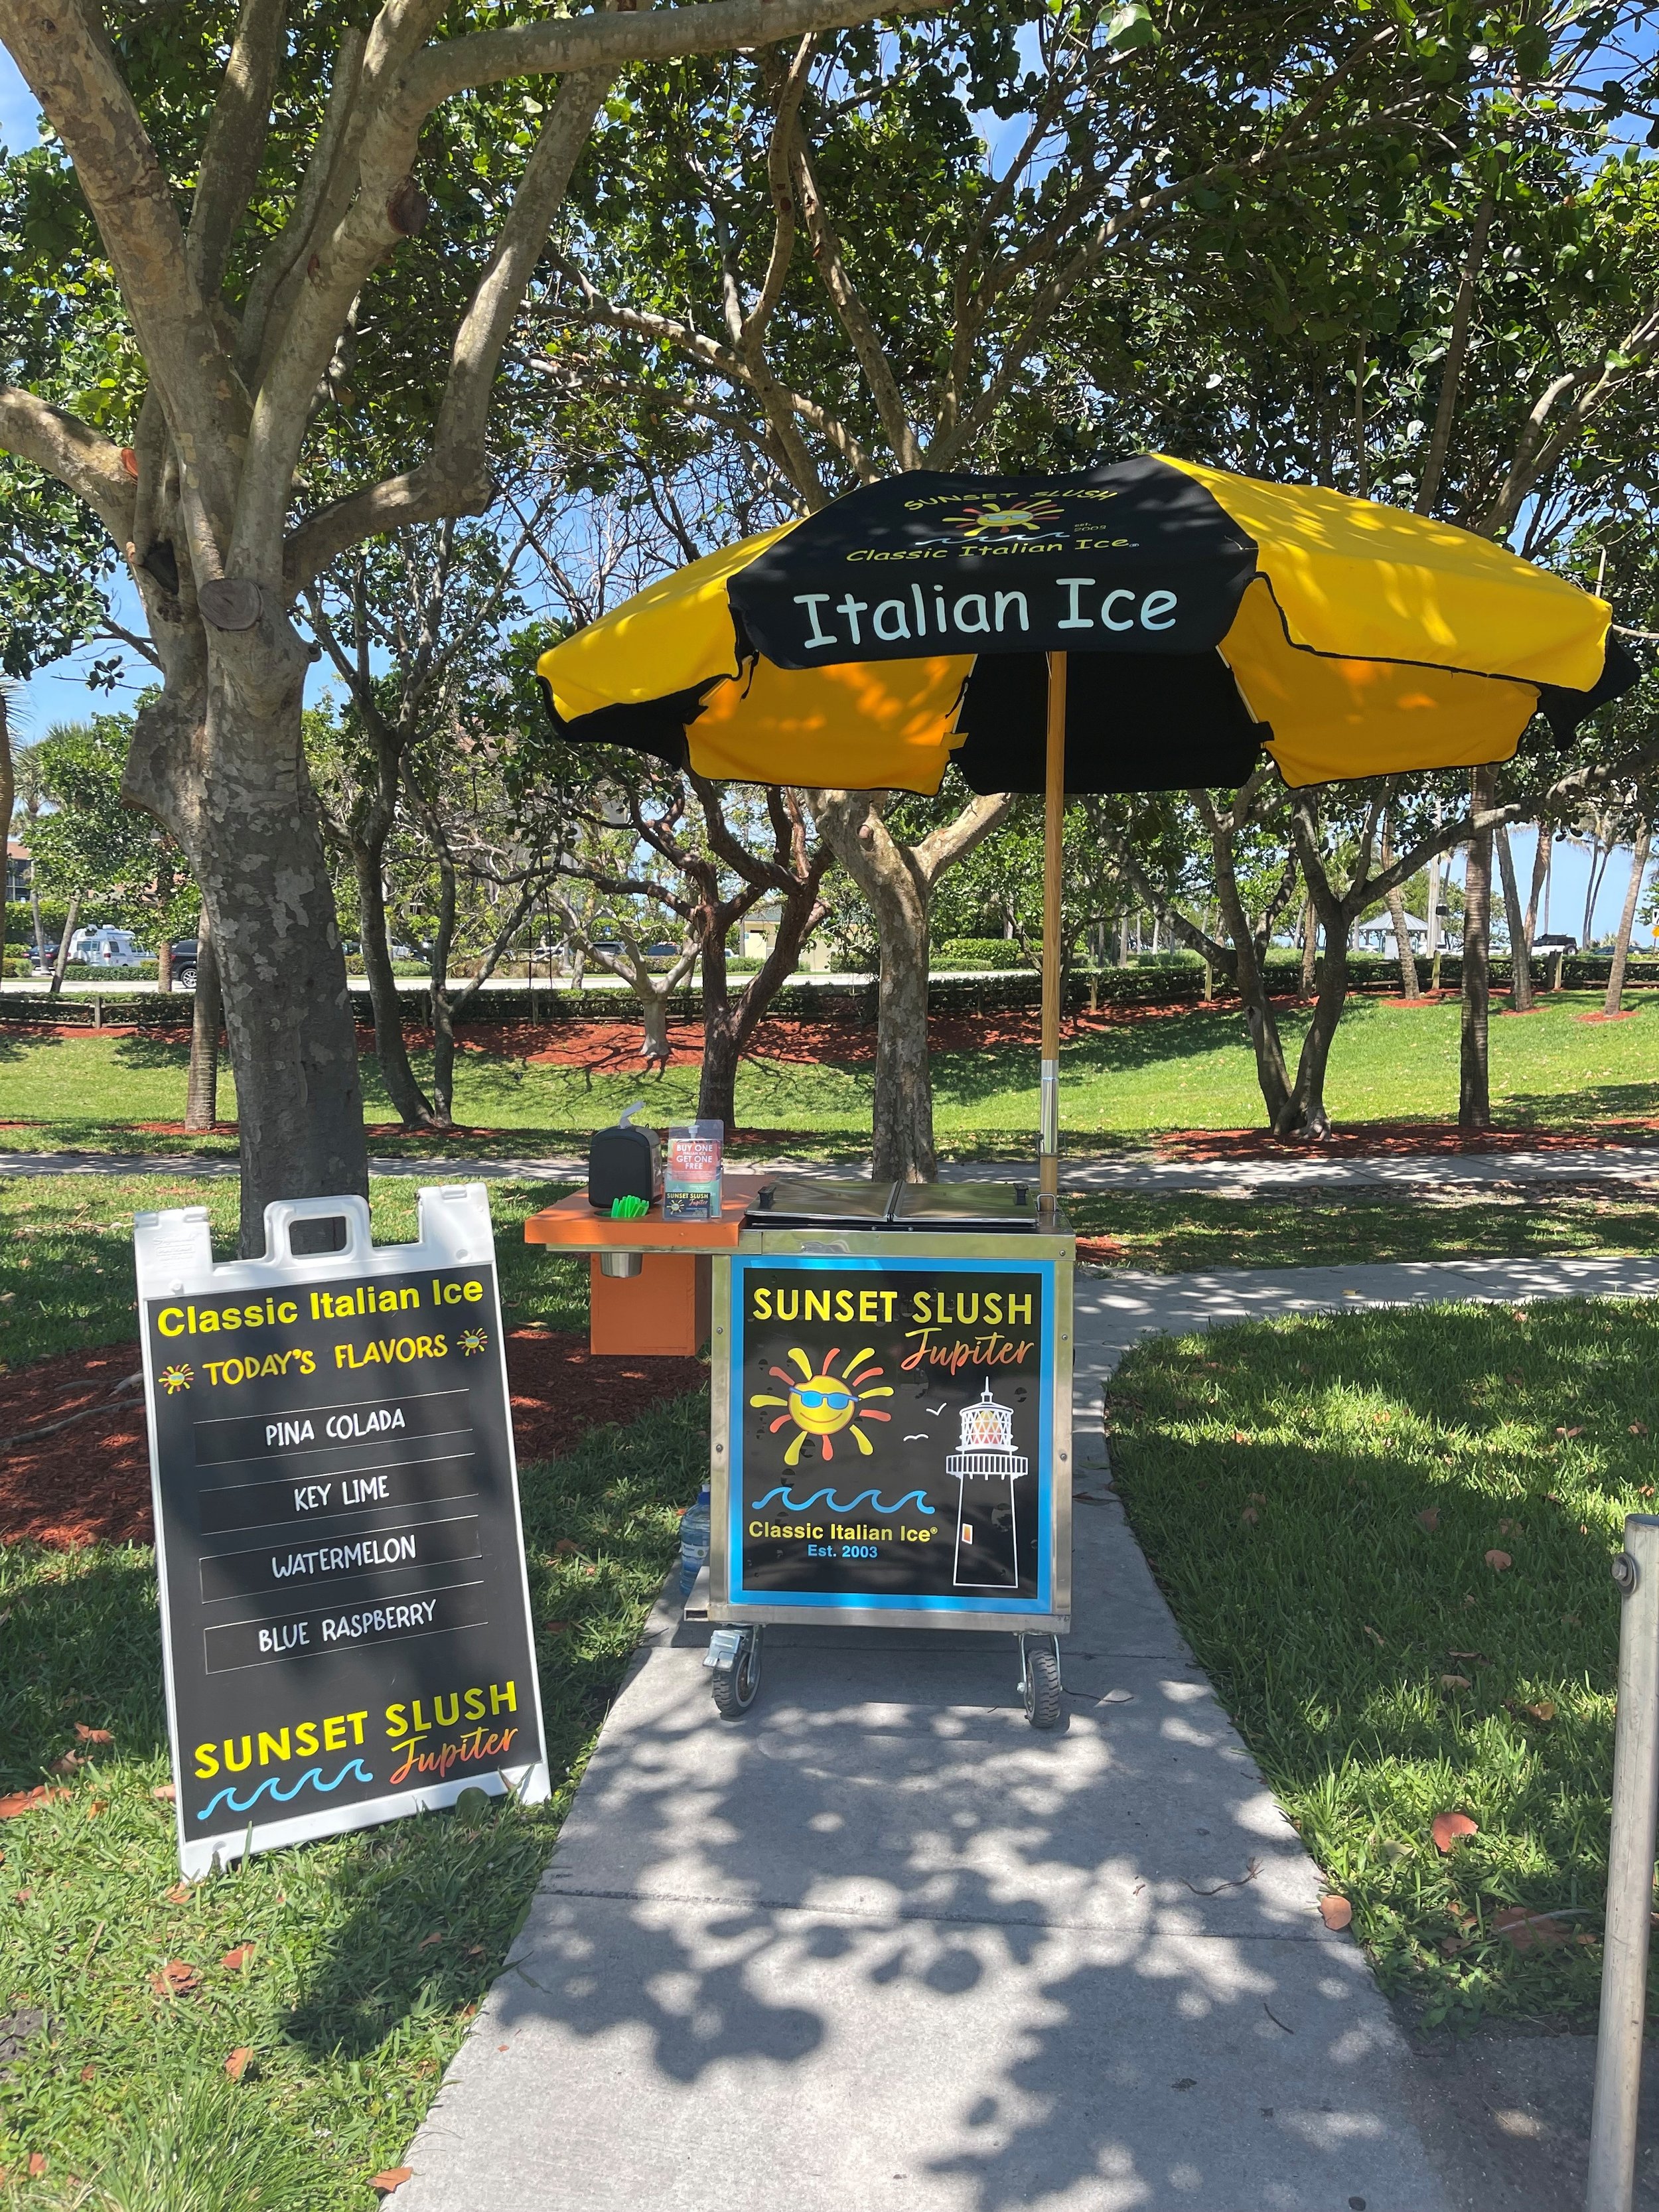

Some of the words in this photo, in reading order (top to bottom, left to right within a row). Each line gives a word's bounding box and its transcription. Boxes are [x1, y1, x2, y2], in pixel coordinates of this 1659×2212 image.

[904, 492, 1020, 512] SUNSET
[1030, 489, 1119, 502] SLUSH
[846, 546, 948, 563] Classic
[958, 542, 1063, 557] Italian
[793, 583, 1029, 649] Italian
[1056, 577, 1178, 632] Ice
[688, 1198, 708, 1207] Jupiter
[157, 1297, 298, 1337] Classic
[309, 1286, 420, 1321] Italian
[432, 1279, 484, 1306] Ice
[753, 1287, 898, 1323] SUNSET
[912, 1291, 1033, 1325] SLUSH
[202, 1348, 317, 1386] TODAY'S
[334, 1334, 449, 1369] FLAVORS
[901, 1327, 1035, 1376] Jupiter
[265, 1420, 315, 1446] PINA
[325, 1408, 406, 1439] COLADA
[294, 1483, 332, 1512] KEY
[342, 1475, 390, 1505] LIME
[749, 1520, 824, 1540] Classic
[830, 1523, 893, 1541] Italian
[271, 1534, 417, 1579] WATERMELON
[807, 1544, 837, 1558] Est.
[841, 1544, 878, 1559] 2003
[257, 1621, 311, 1653] BLUE
[322, 1598, 437, 1641] RASPBERRY
[194, 1710, 368, 1779] SUNSET
[385, 1680, 518, 1737] SLUSH
[389, 1726, 519, 1785] Jupiter
